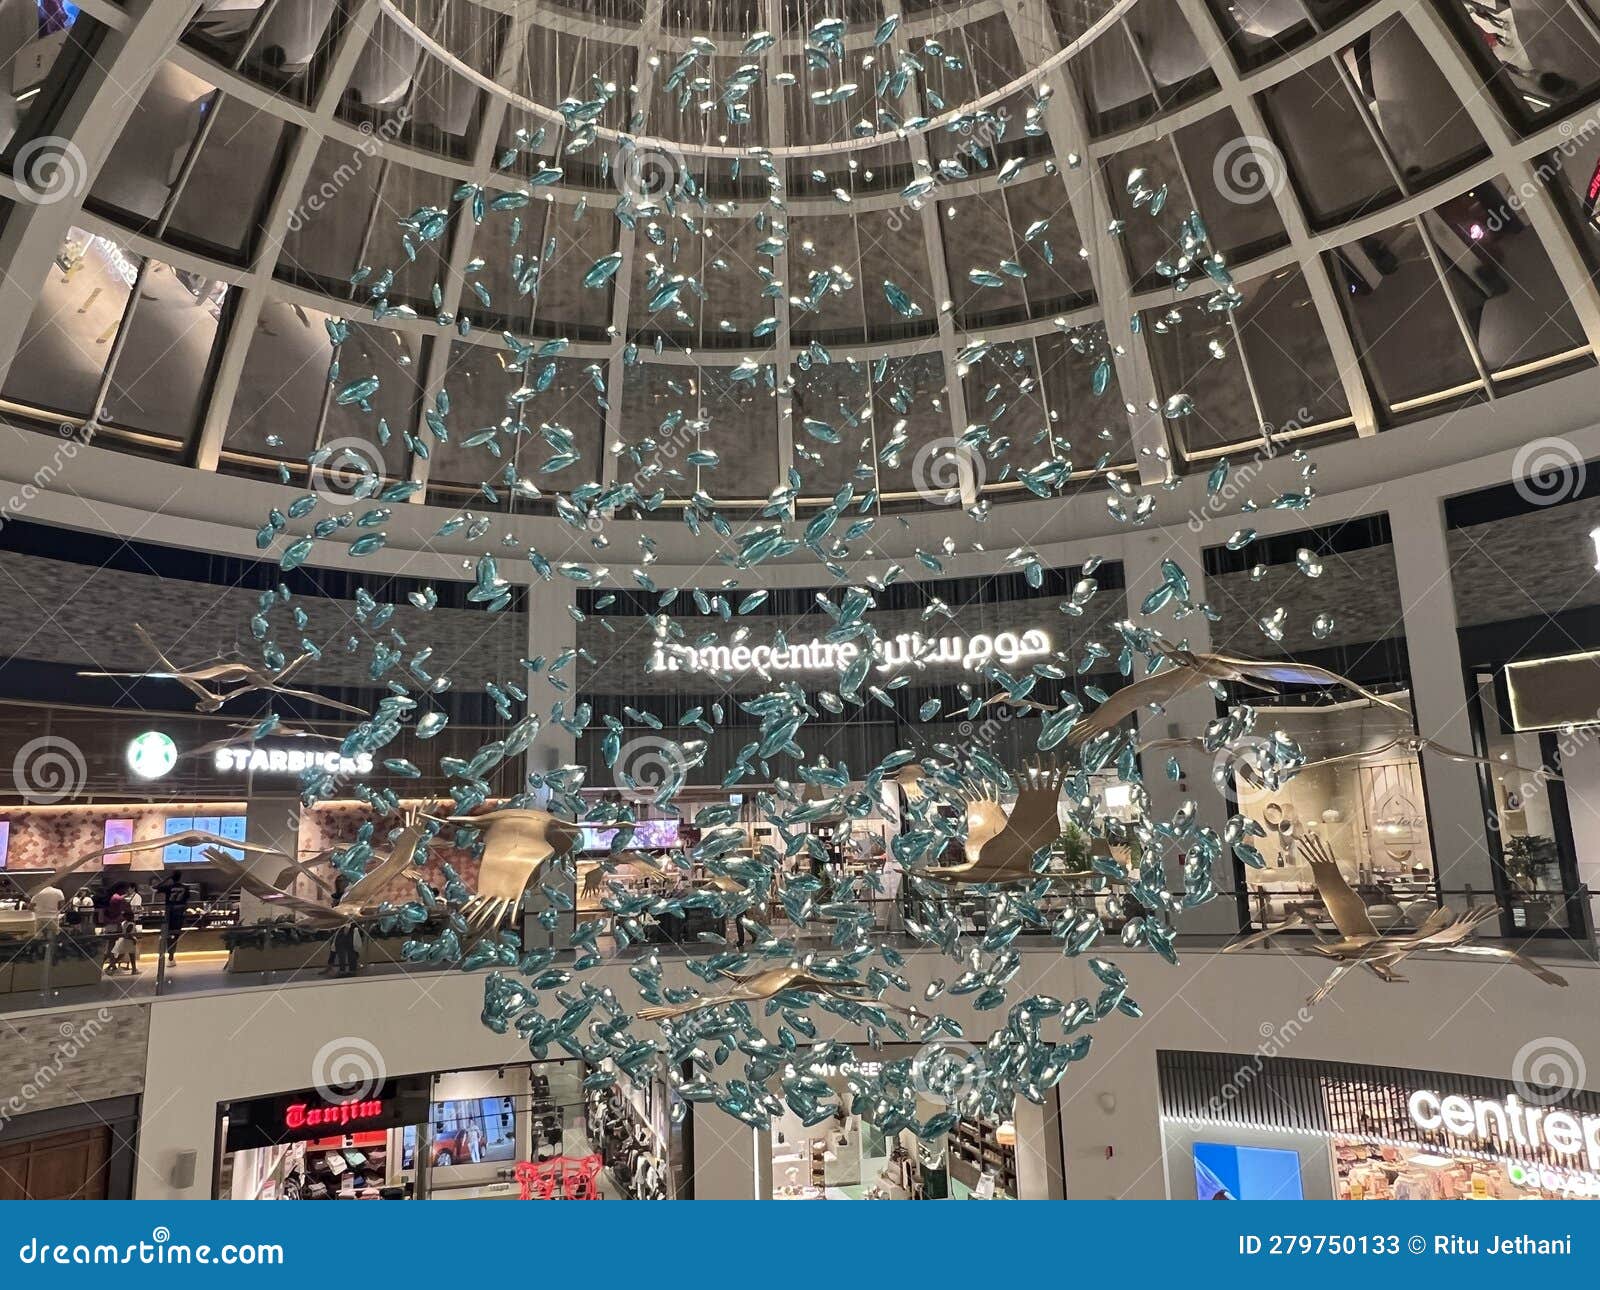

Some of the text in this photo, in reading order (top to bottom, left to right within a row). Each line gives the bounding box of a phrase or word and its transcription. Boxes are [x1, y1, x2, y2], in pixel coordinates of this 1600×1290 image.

[963, 629, 1050, 670] هوم
[215, 748, 374, 773] STARBUCKS
[286, 1099, 382, 1128] Tanjim
